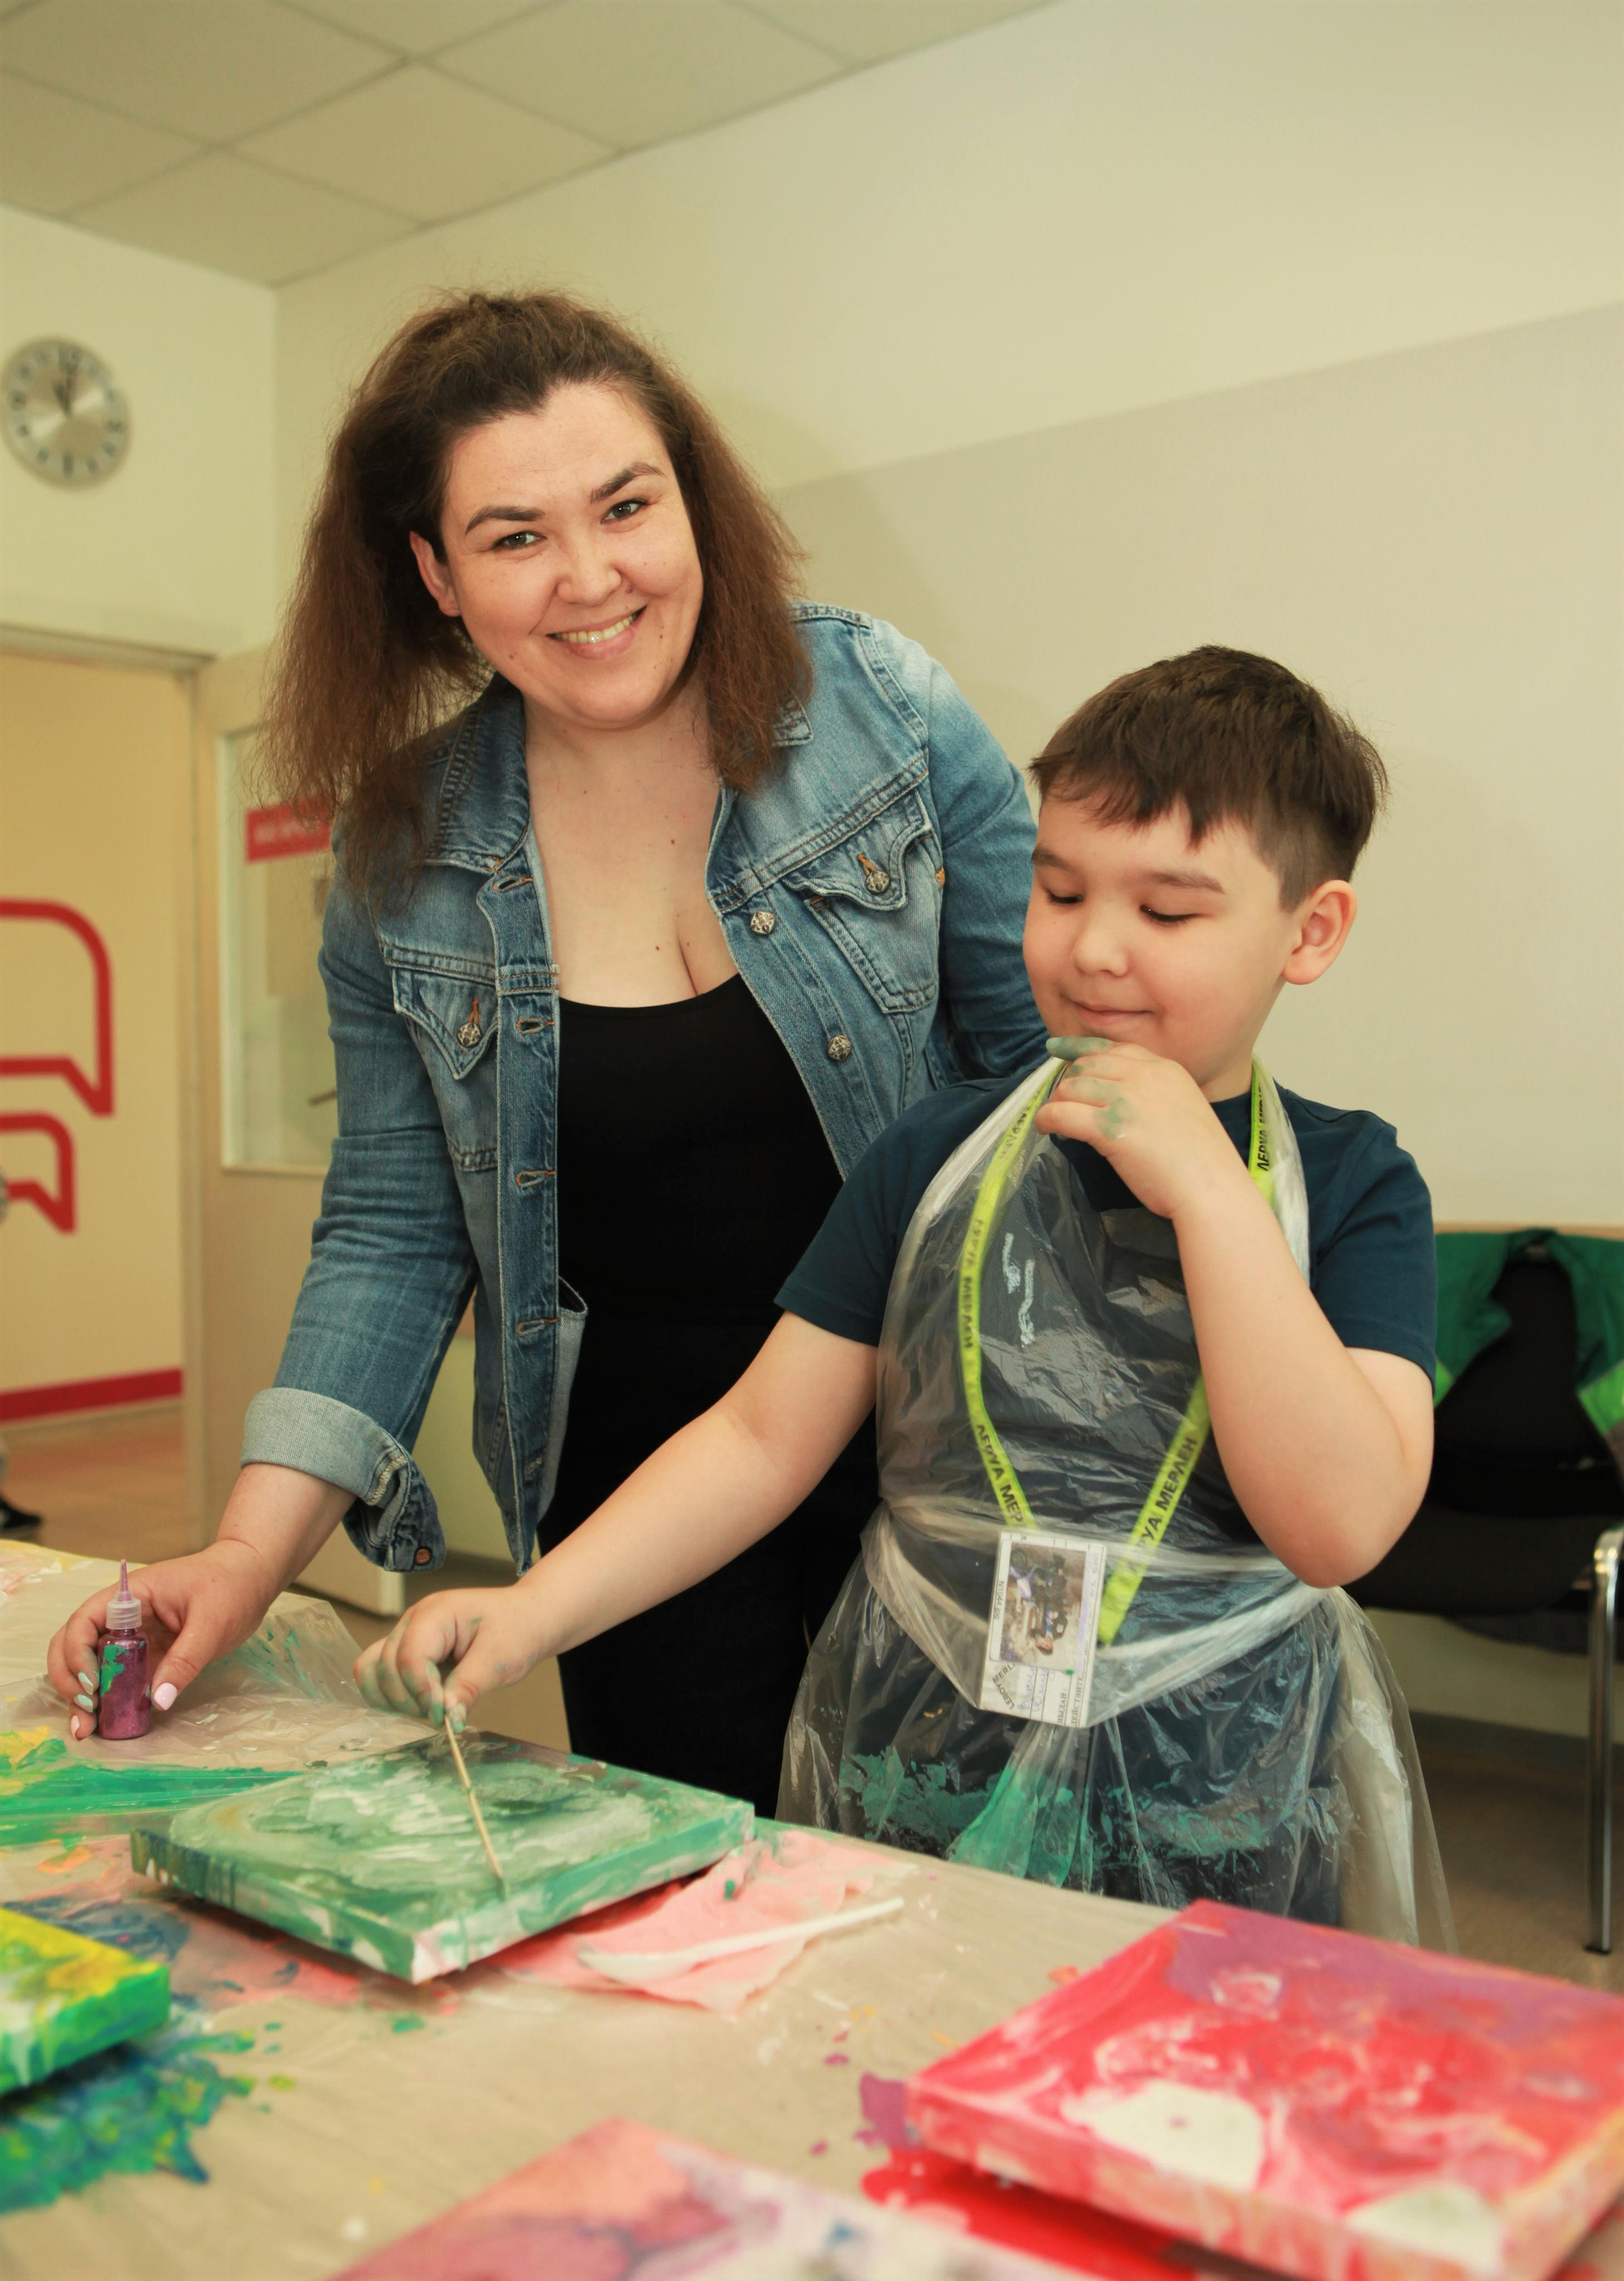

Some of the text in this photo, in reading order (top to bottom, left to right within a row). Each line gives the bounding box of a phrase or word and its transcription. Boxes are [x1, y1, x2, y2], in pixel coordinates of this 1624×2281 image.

[976, 1424, 1023, 1525] ЛЕРУА МЕР
[1156, 1437, 1198, 1511] МЕРЛЕН
[996, 1683, 1015, 1710] LEROY
